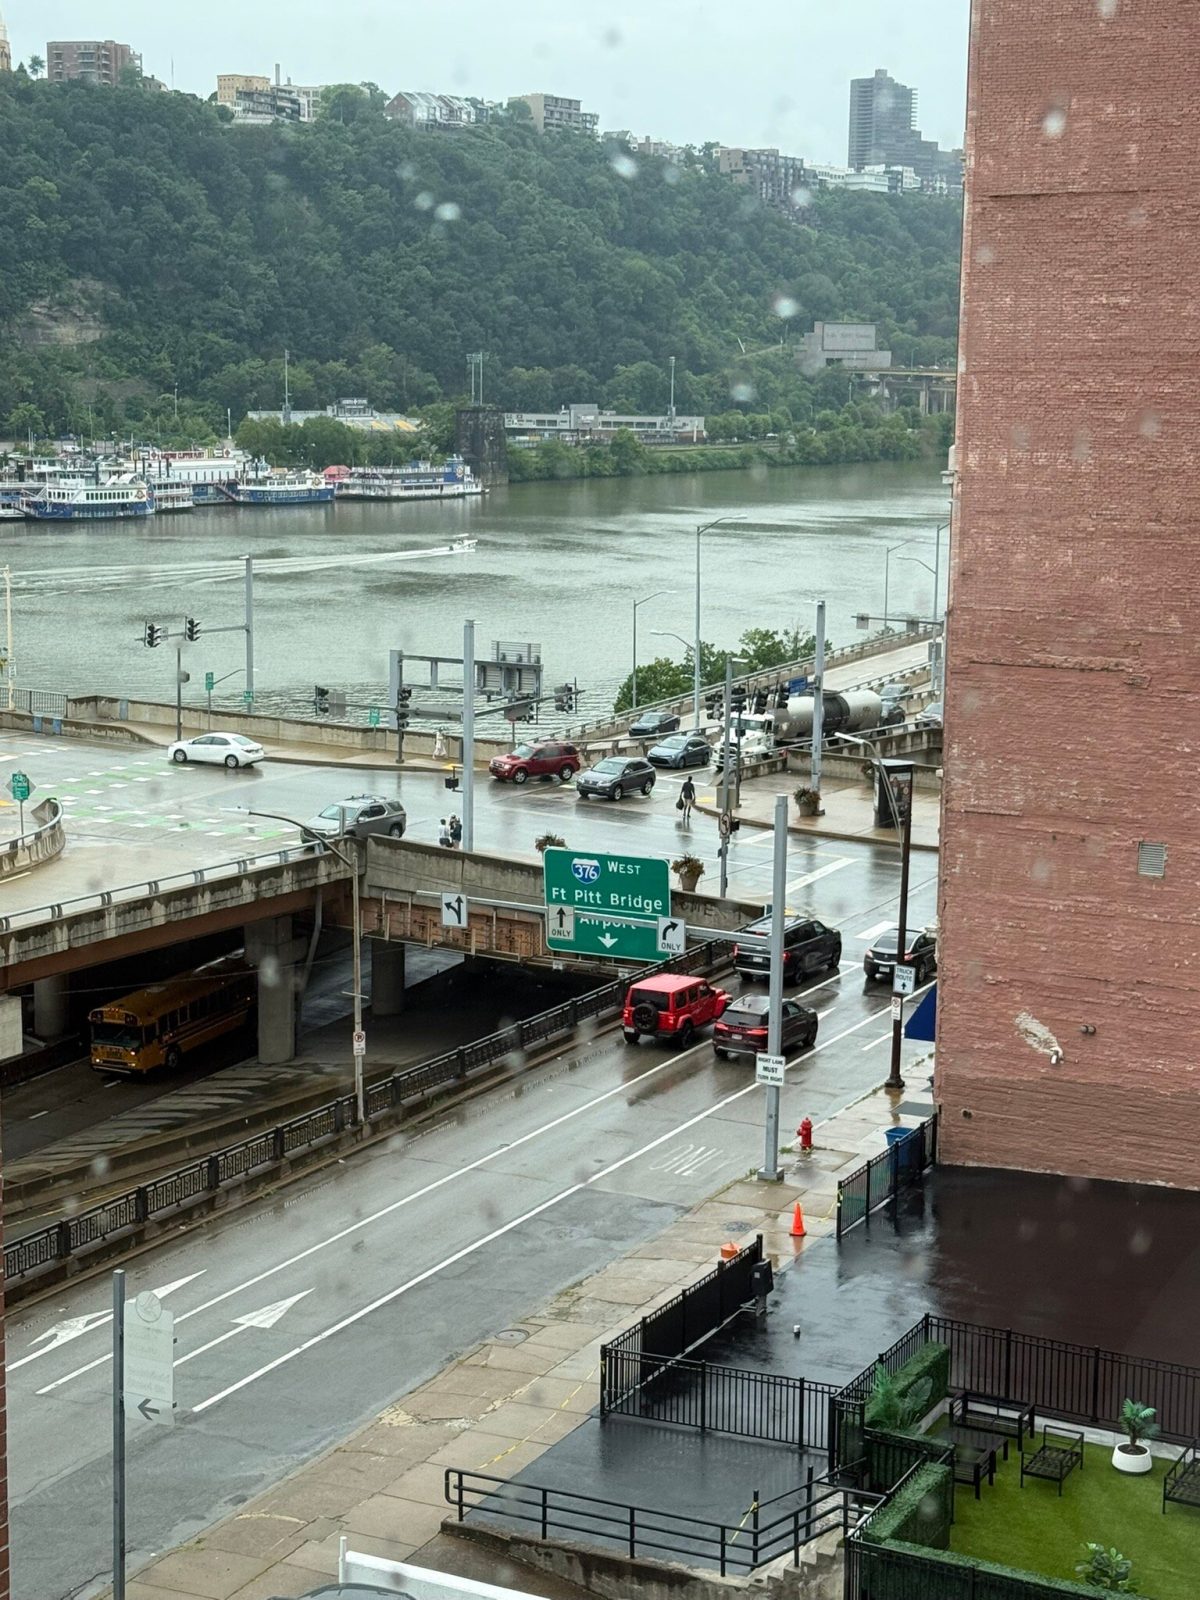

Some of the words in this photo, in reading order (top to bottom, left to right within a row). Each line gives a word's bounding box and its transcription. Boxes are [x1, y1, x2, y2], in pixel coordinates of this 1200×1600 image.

[574, 864, 598, 879] 376
[607, 860, 641, 875] WEST
[552, 887, 567, 901] Ft
[574, 889, 602, 904] Pitt
[610, 893, 663, 913] Bridge
[551, 929, 571, 937] ONLY
[661, 942, 681, 951] ONLY
[896, 967, 912, 975] TRUCK
[896, 974, 912, 982] ROUTE
